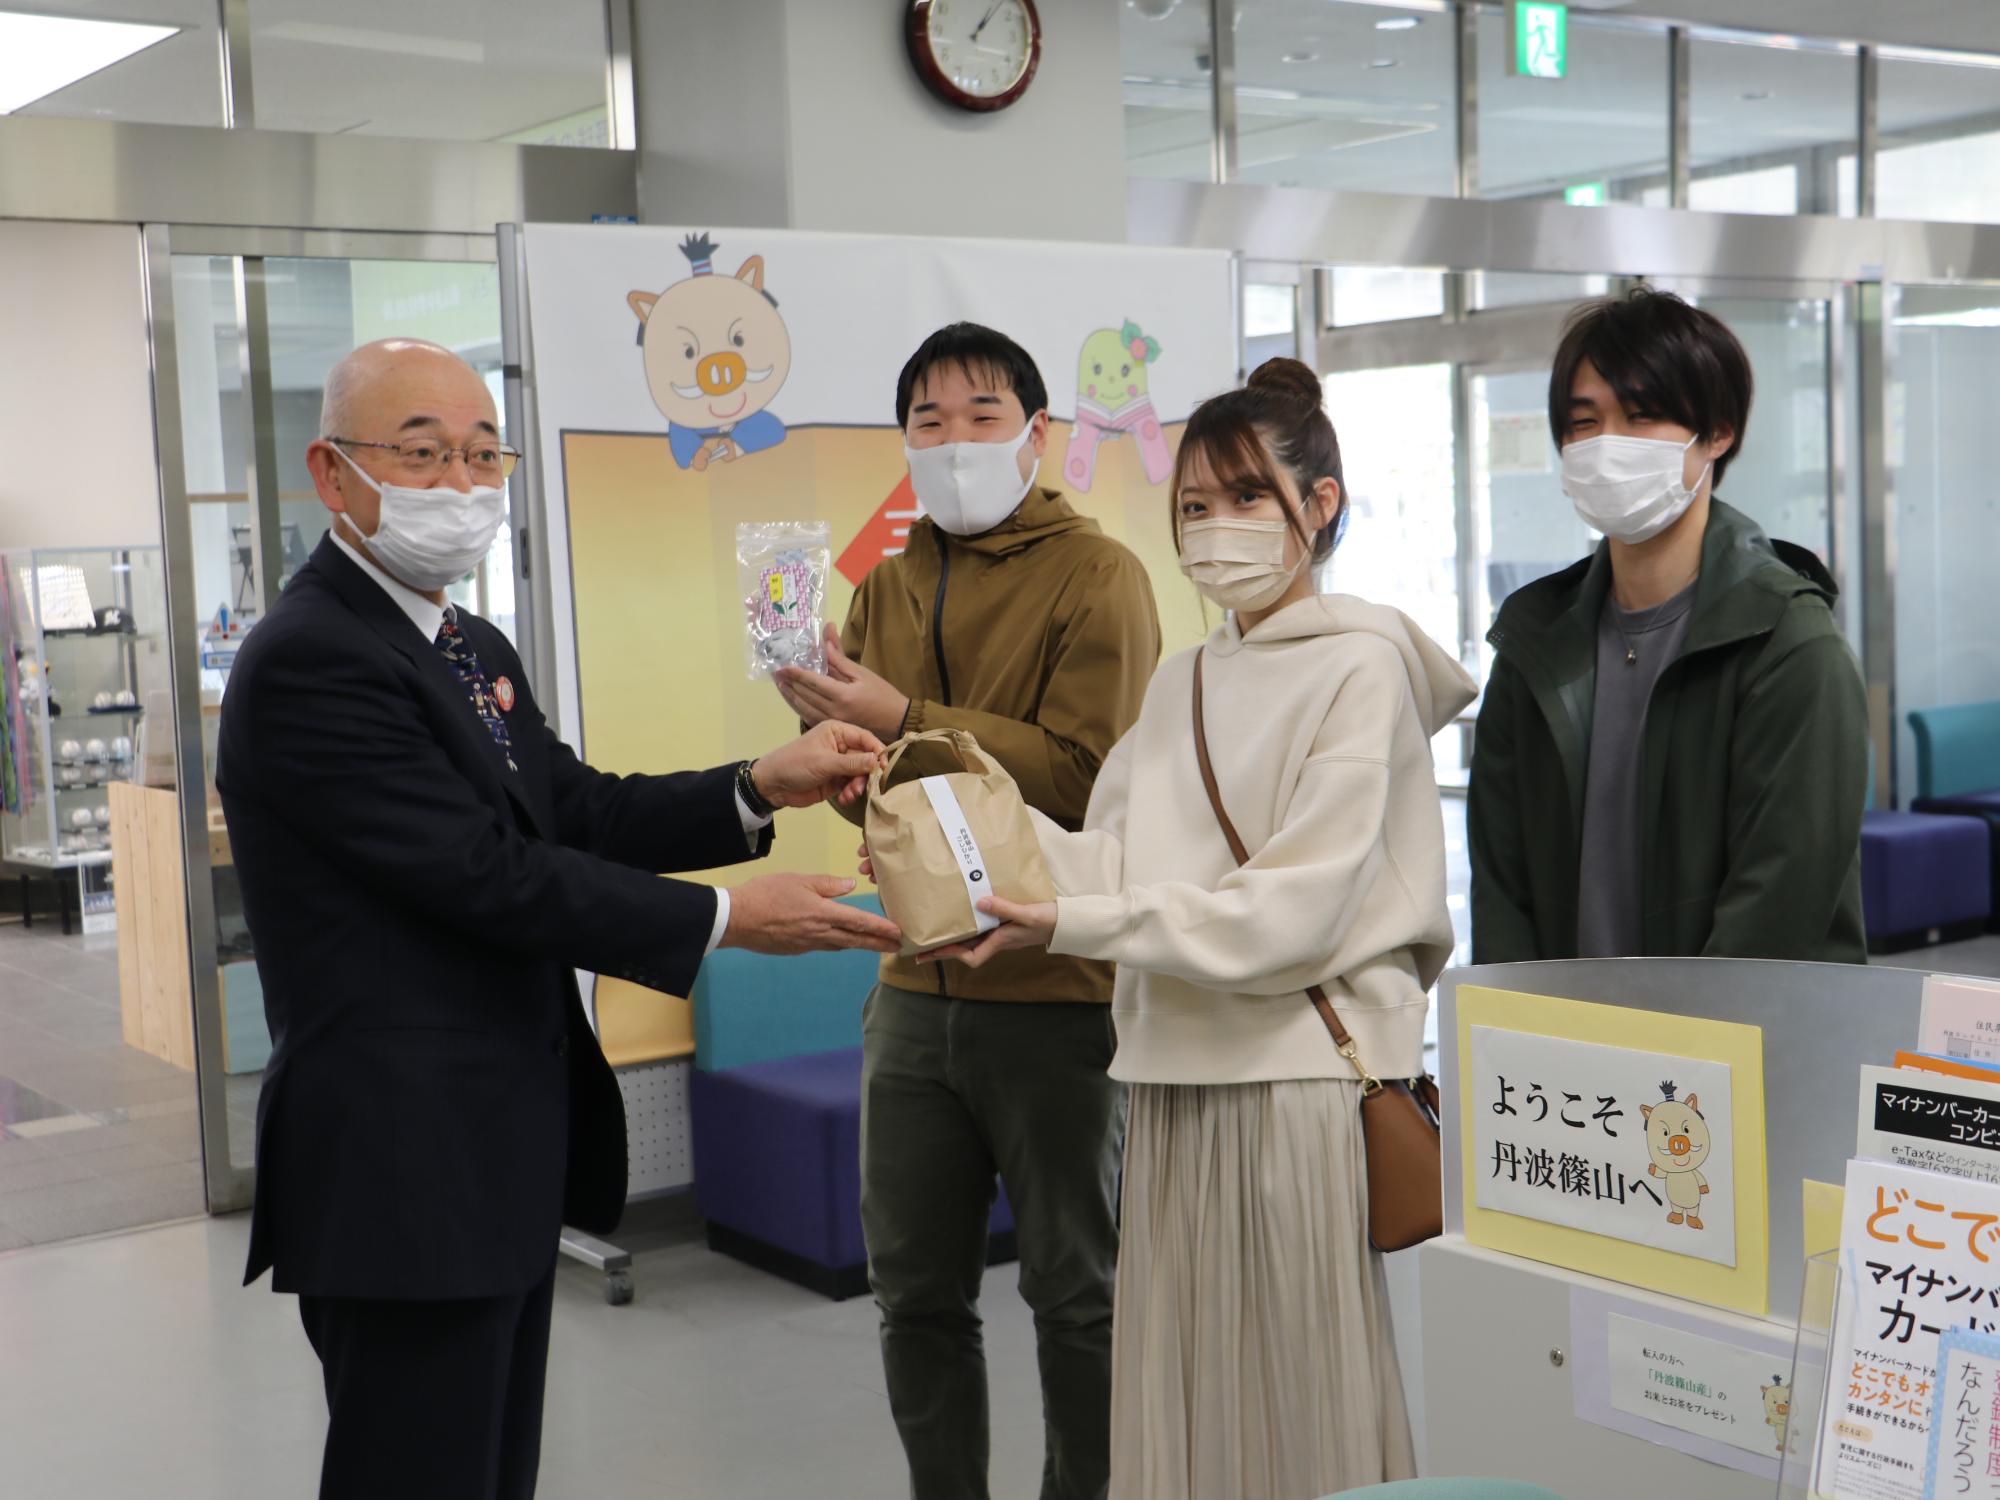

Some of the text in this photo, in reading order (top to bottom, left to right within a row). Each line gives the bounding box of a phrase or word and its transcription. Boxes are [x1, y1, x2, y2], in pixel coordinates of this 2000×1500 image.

[1492, 1075, 1624, 1138] ようこそ
[1881, 1091, 2000, 1125] マイナンバーカー
[1490, 1139, 1663, 1207] 丹波篠山へ
[1866, 1185, 2000, 1264] どこで
[1642, 1346, 1685, 1366] 転入の方へ
[1644, 1389, 1737, 1425] お米とお茶をプレゼント
[1953, 1361, 1983, 1494] なんだろう
